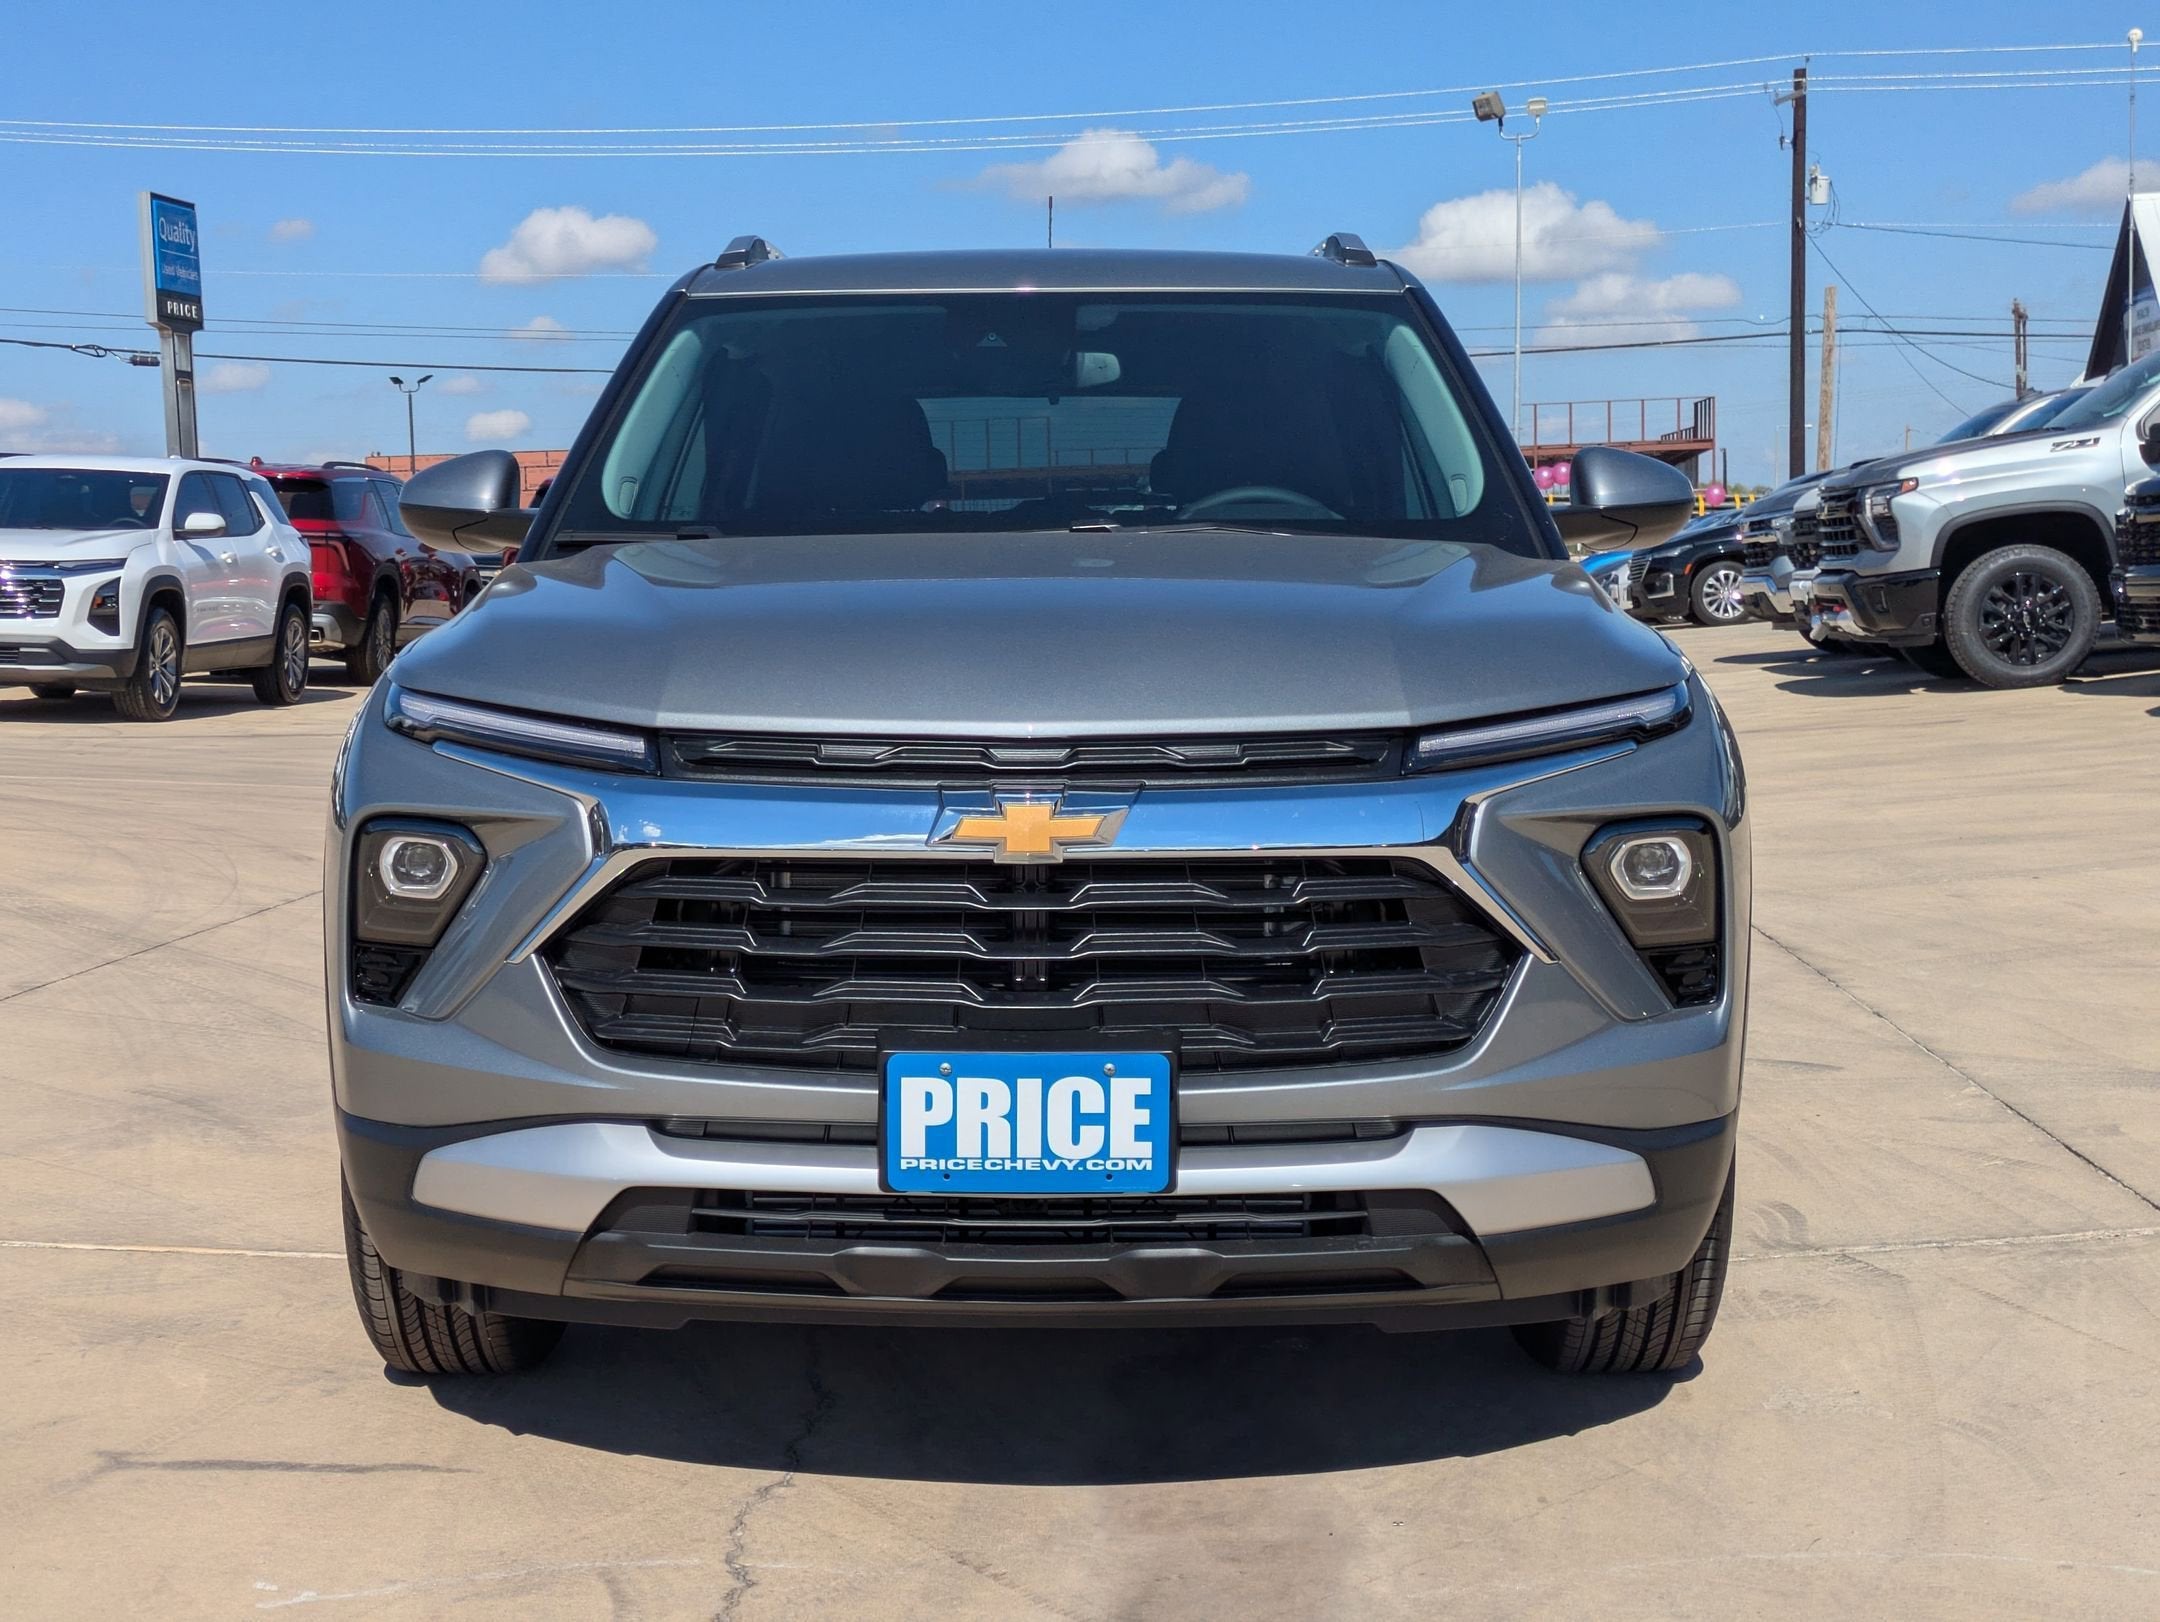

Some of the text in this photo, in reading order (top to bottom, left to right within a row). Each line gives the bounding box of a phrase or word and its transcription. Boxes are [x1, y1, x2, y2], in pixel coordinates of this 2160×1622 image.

[159, 217, 196, 252] Quality
[167, 300, 198, 319] PRICE
[900, 1076, 1152, 1160] PRICE
[900, 1158, 1153, 1171] PRICECHEVY.COM
